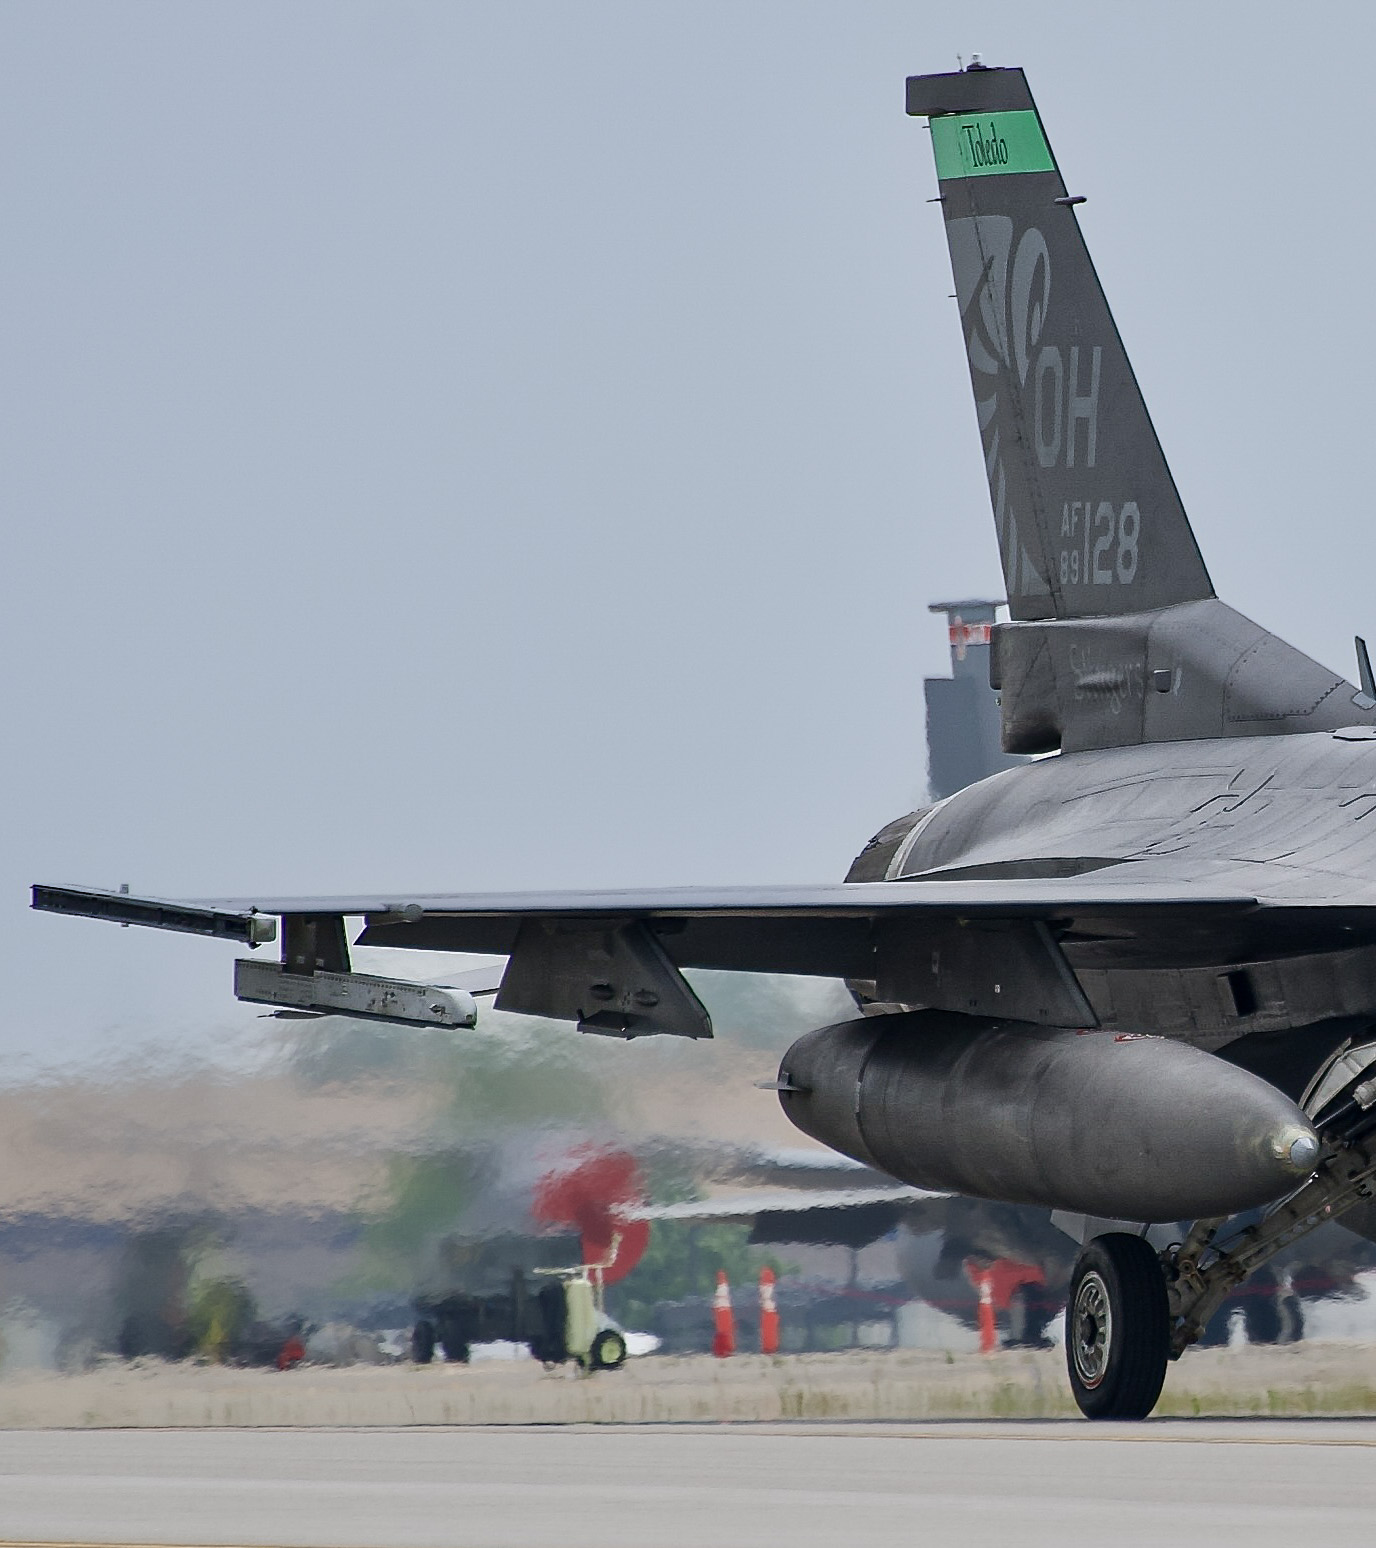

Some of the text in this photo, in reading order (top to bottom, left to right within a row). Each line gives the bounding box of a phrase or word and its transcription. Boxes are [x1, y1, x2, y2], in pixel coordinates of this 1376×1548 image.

[961, 121, 1009, 168] Toledo
[1034, 345, 1102, 468] OH
[1060, 501, 1082, 537] AF
[1083, 501, 1141, 585] 128
[1060, 550, 1080, 585] 89
